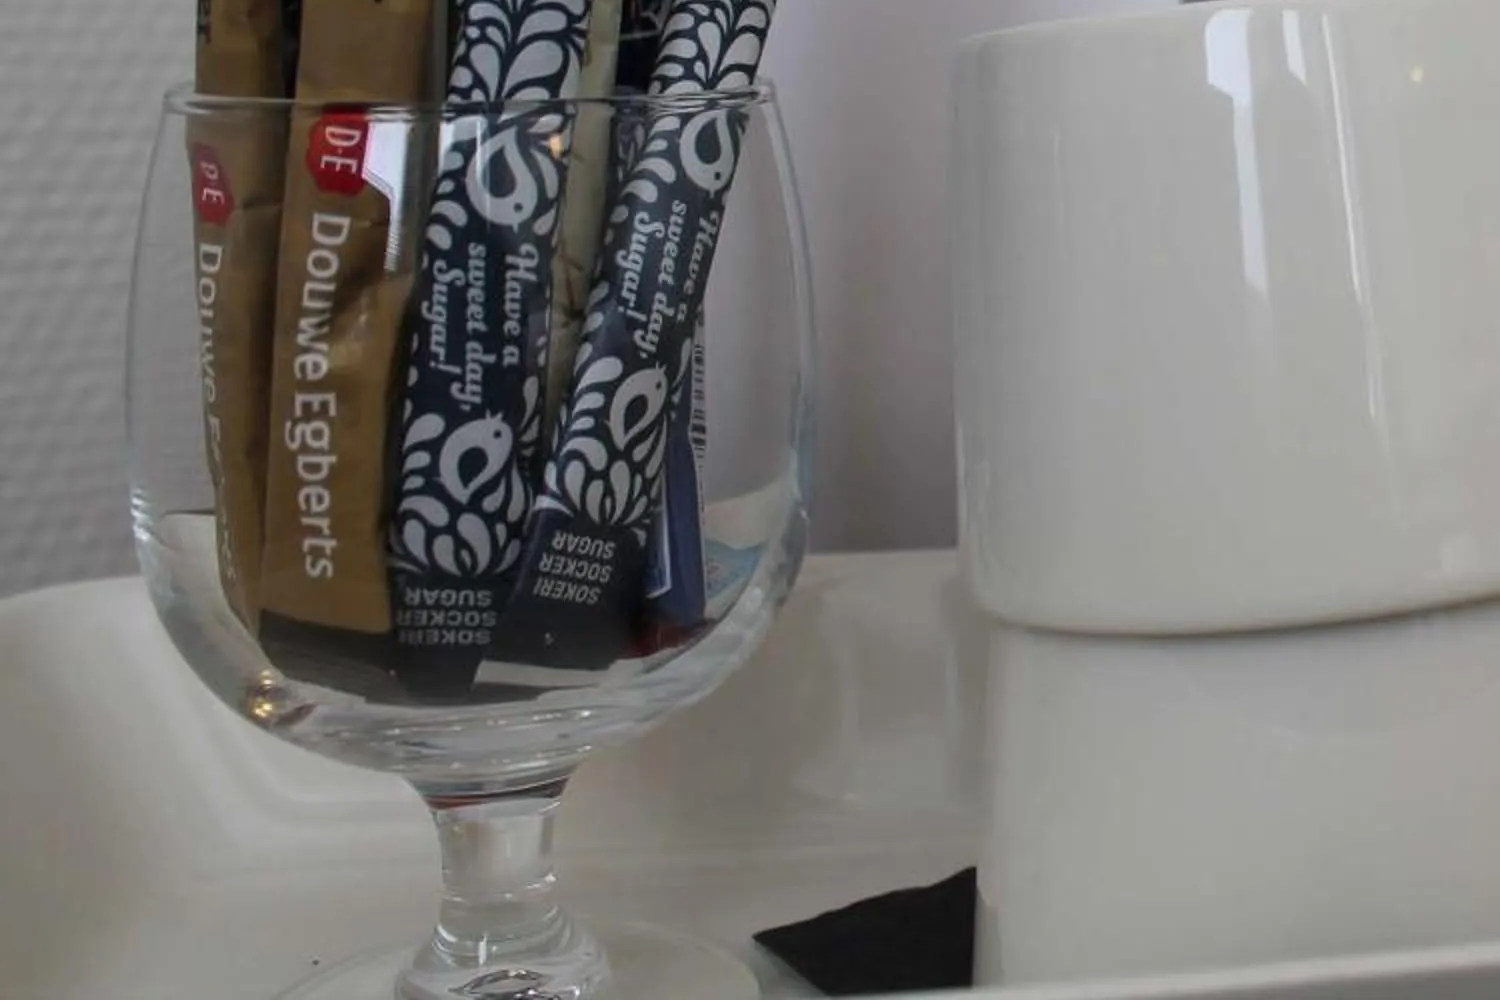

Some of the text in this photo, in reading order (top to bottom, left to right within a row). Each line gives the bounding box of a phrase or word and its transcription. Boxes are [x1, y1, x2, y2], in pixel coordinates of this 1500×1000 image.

[421, 259, 466, 374] Sugar!
[503, 243, 539, 367] Have a
[615, 211, 665, 321] Sugar!
[633, 200, 687, 359] sweet day,
[676, 211, 720, 323] Have a
[450, 242, 497, 411] sweet day,
[285, 213, 350, 578] Douwe Egberts
[405, 587, 493, 607] SUGAR
[533, 576, 601, 605] SOKERI
[539, 552, 612, 583] SOCKER
[552, 530, 616, 559] SUGAR
[396, 610, 497, 627] SOCKER
